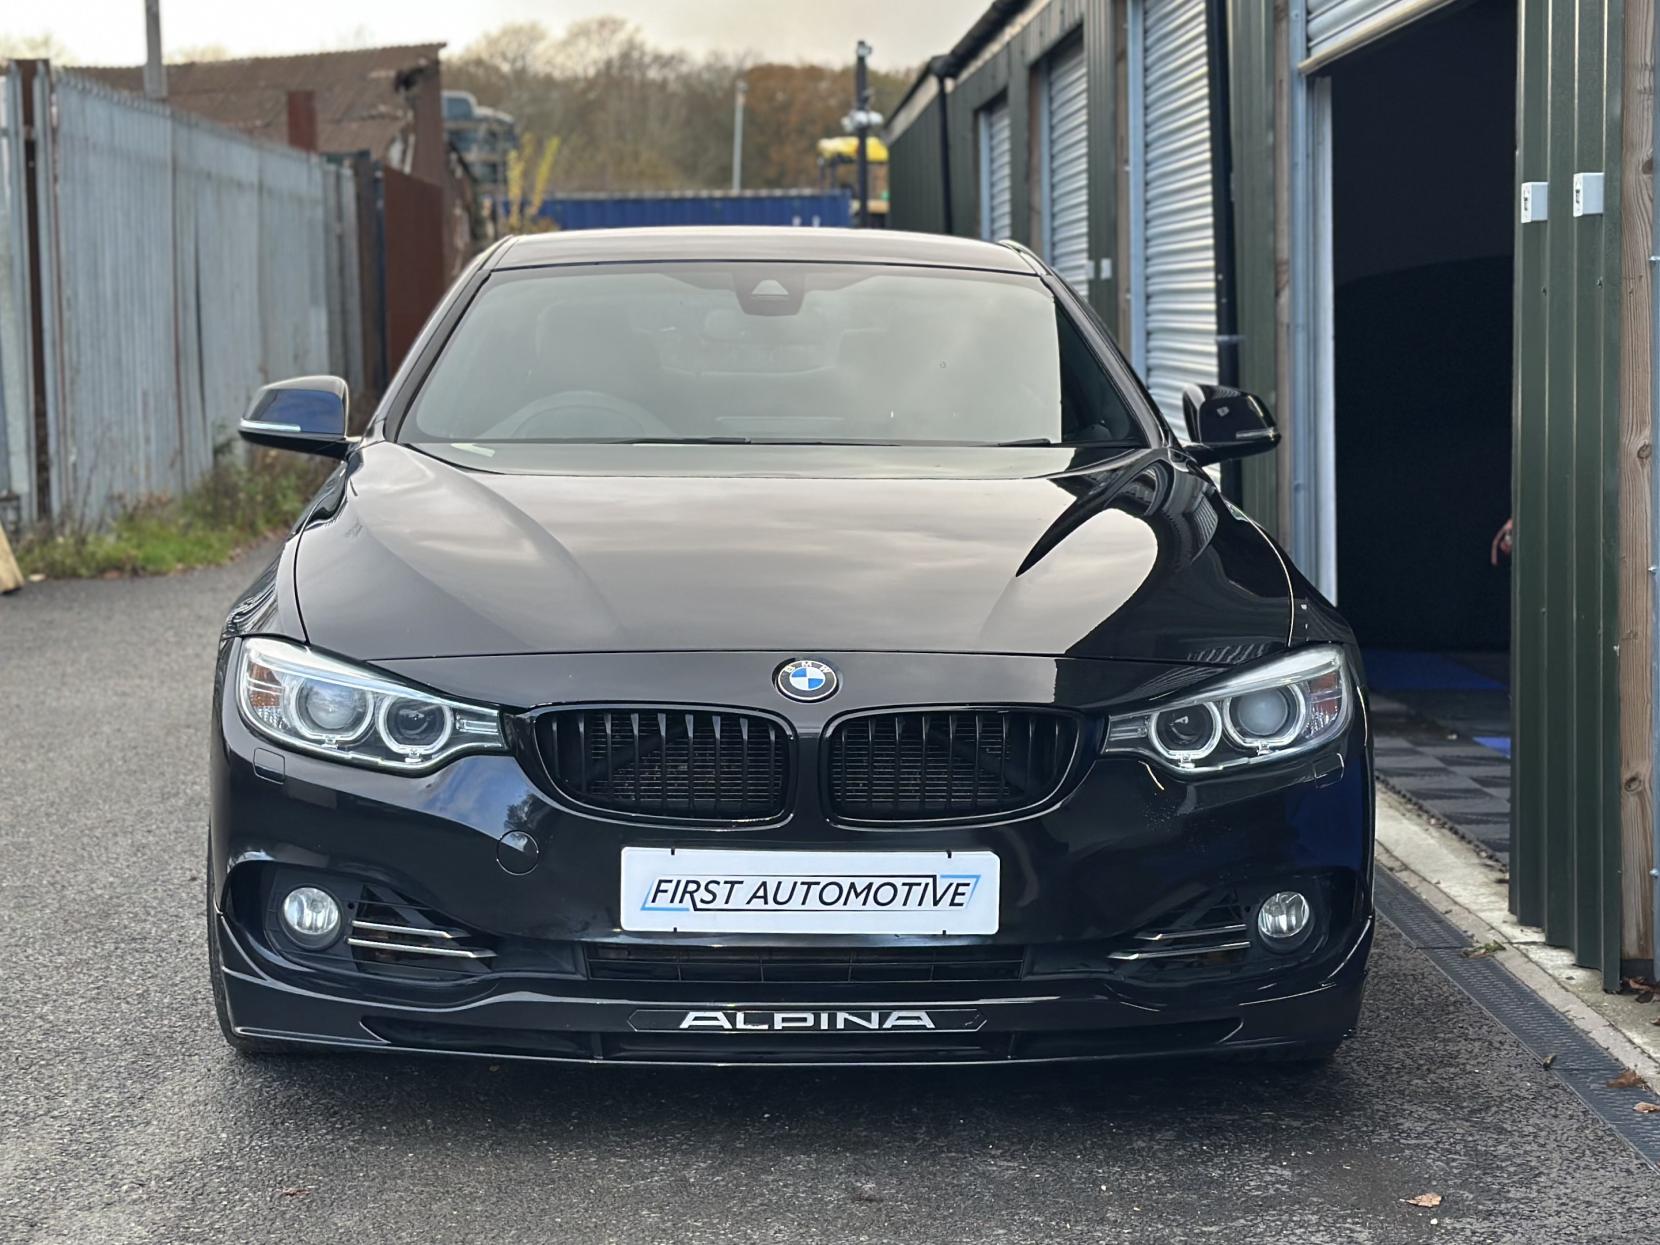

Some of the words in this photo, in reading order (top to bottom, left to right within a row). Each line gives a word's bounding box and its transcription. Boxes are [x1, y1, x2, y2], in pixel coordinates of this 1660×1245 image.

[784, 661, 831, 673] BMW
[650, 879, 744, 908] FIRST
[746, 877, 971, 908] AUTOMOTIVE
[679, 1010, 936, 1030] ALPINA
